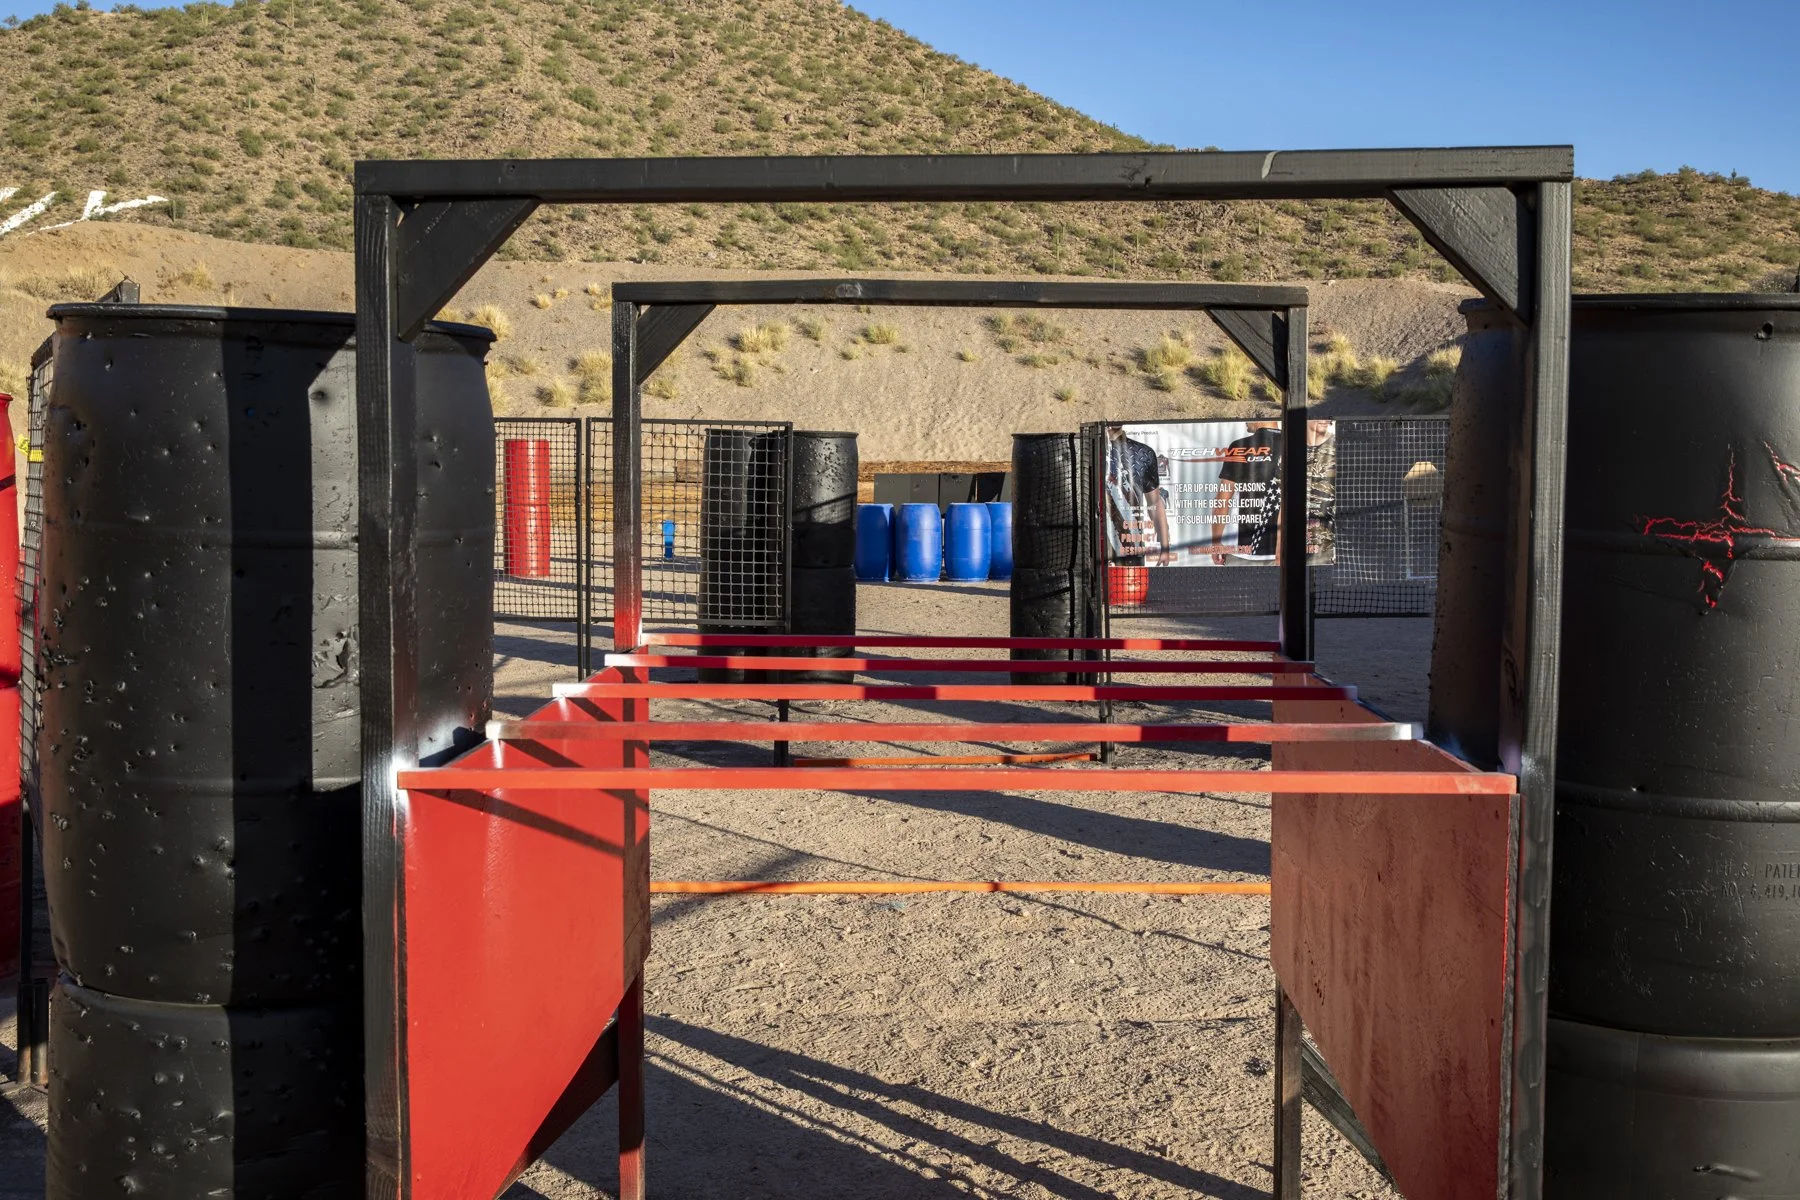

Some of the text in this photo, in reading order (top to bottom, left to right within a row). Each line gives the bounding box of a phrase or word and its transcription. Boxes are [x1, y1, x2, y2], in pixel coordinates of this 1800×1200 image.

[1170, 447, 1271, 457] TECHWEAR
[1174, 482, 1266, 493] GEAR UP FOR ALL SEASONS
[1174, 498, 1266, 509] WITH THE BEST SELECTION
[1176, 514, 1263, 524] OF SUBLIMATED APPAREL
[1765, 863, 1800, 879] PATE
